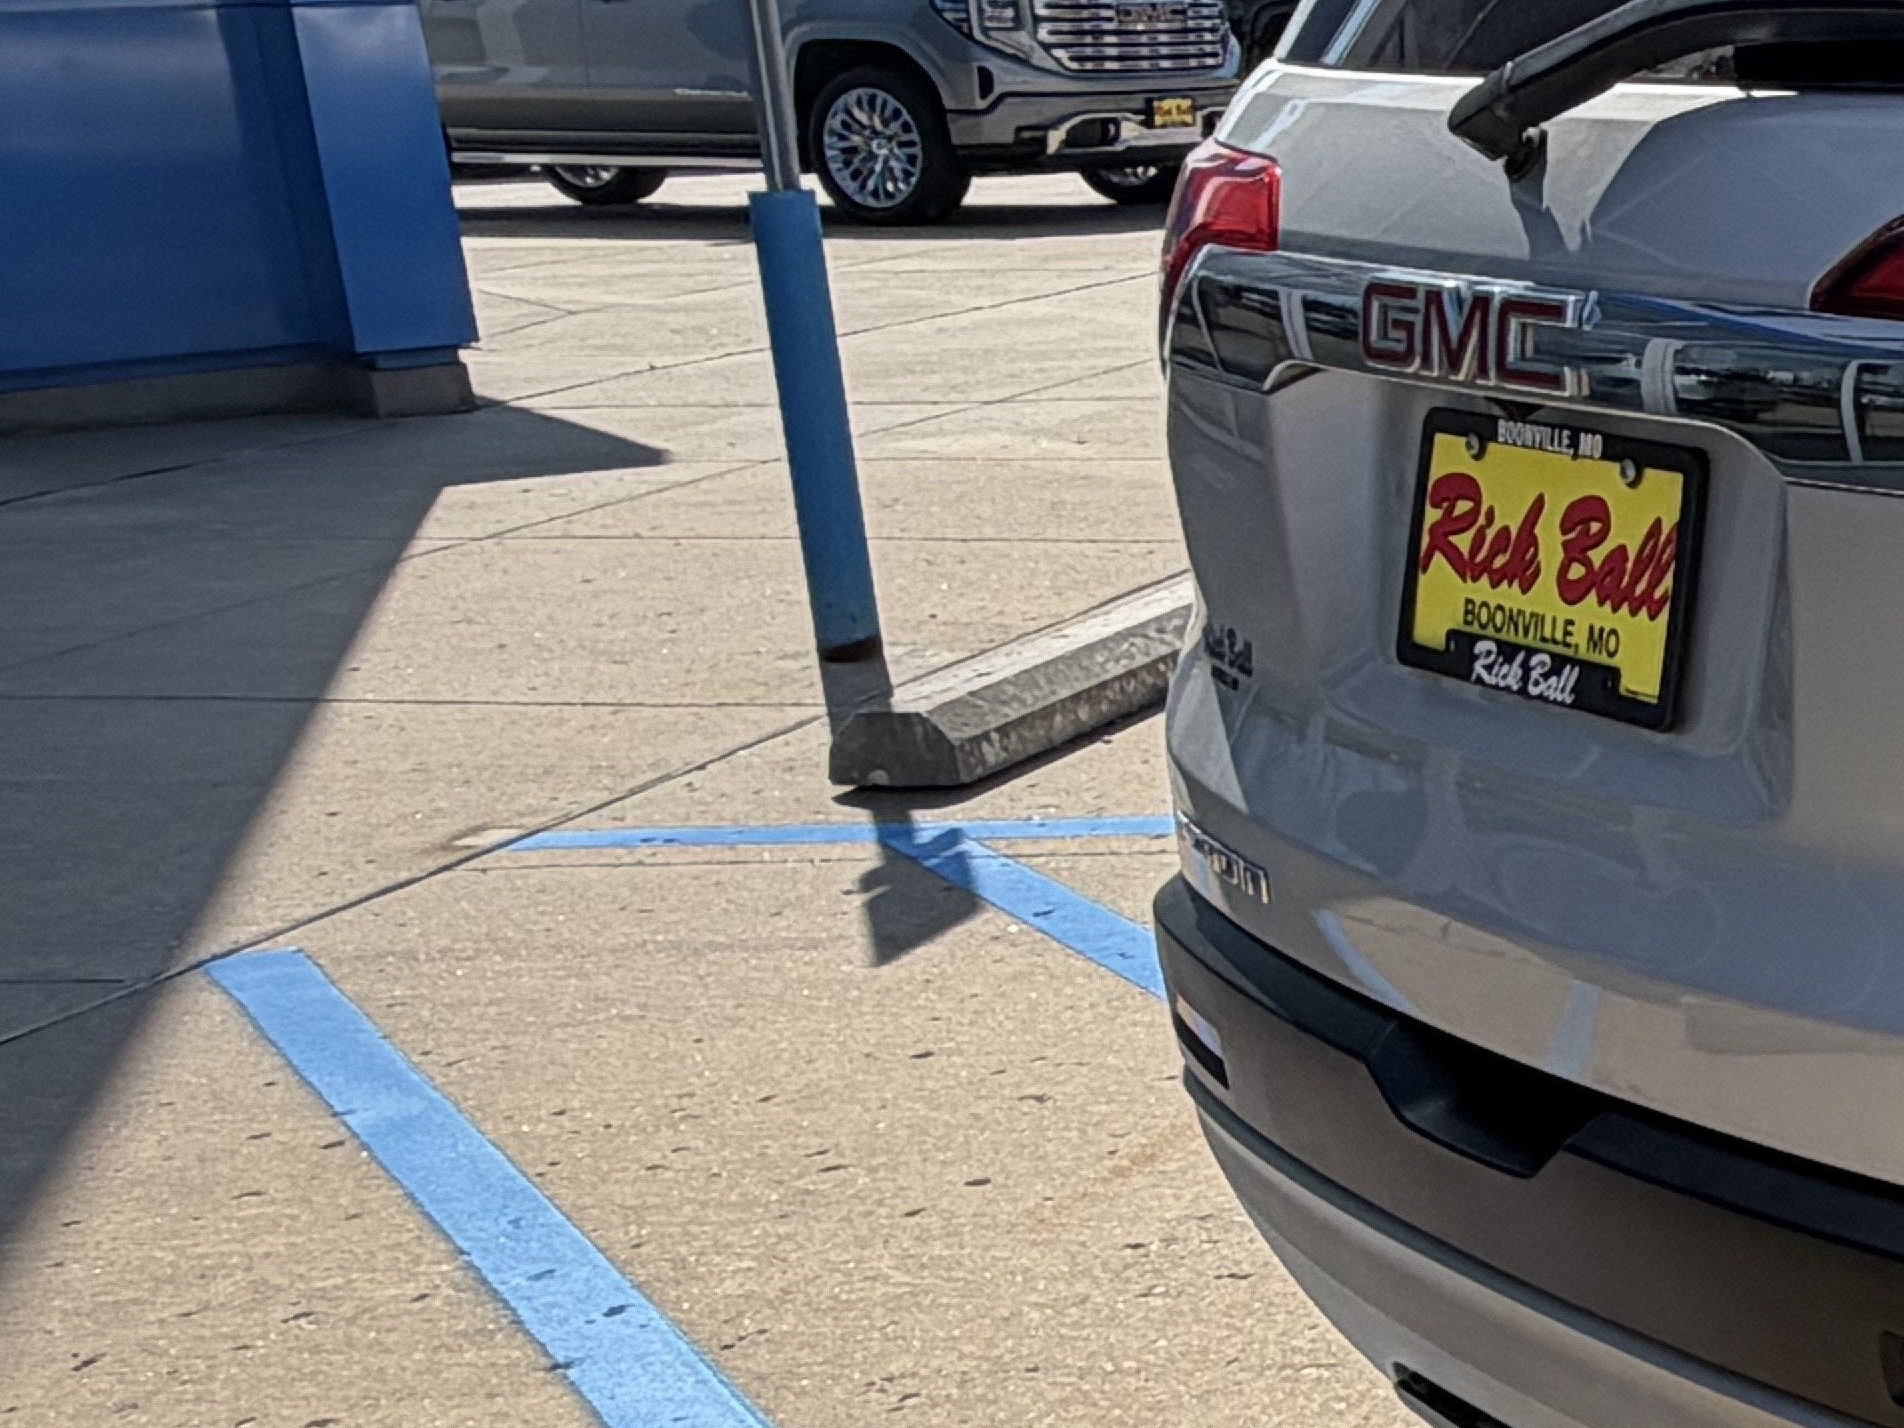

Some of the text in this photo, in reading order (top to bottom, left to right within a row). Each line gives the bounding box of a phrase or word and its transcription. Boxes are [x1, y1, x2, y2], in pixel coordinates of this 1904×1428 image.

[1362, 276, 1582, 397] GMC
[1497, 419, 1604, 459] BOONVILLE, MO
[1419, 472, 1681, 622] Rick Ball
[1463, 597, 1620, 658] BOONVILLE, MO
[1471, 639, 1580, 704] Rick Ball
